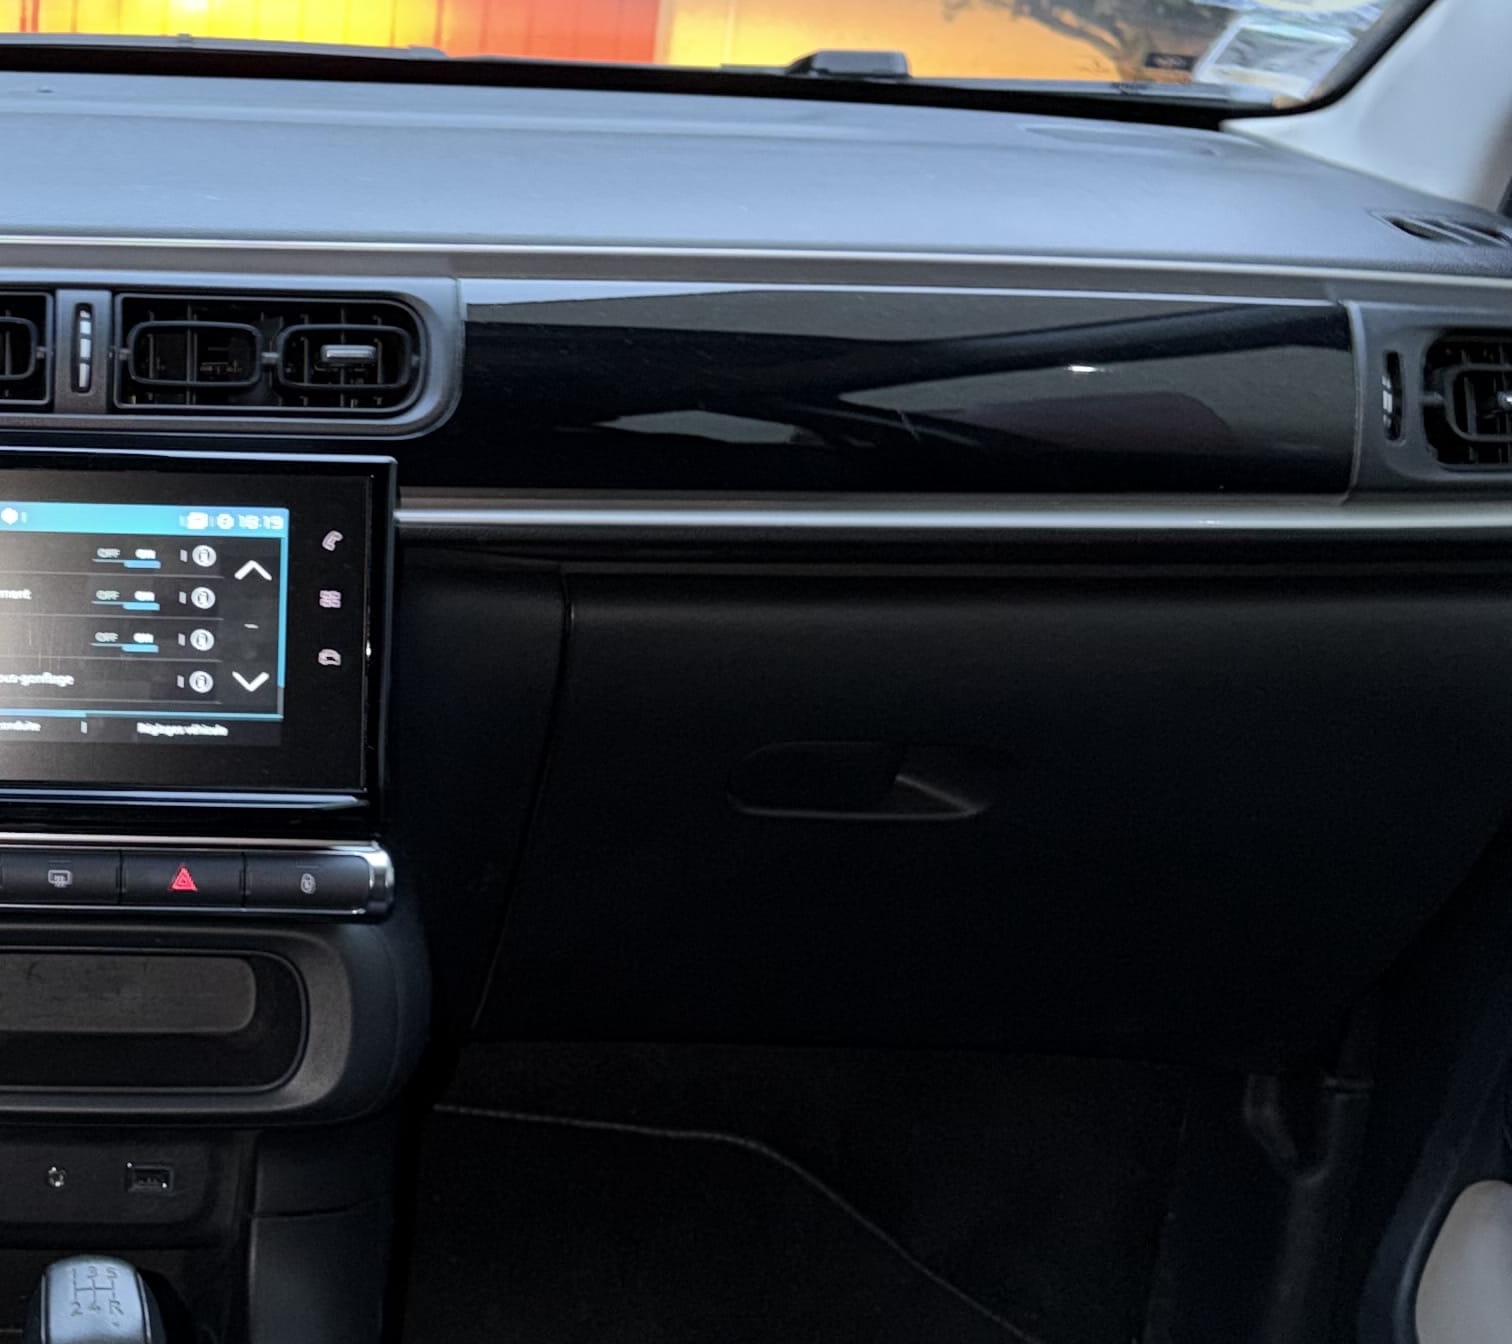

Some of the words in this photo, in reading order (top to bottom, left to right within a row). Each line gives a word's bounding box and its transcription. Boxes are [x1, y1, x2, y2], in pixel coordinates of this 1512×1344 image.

[96, 547, 121, 558] OFF
[135, 548, 157, 559] ON
[95, 589, 120, 601] OFF
[133, 590, 156, 602] ON
[94, 631, 119, 643] OFF
[133, 632, 155, 643] ON
[88, 1266, 98, 1279] 3
[70, 1300, 83, 1317] 2
[109, 1299, 125, 1316] R
